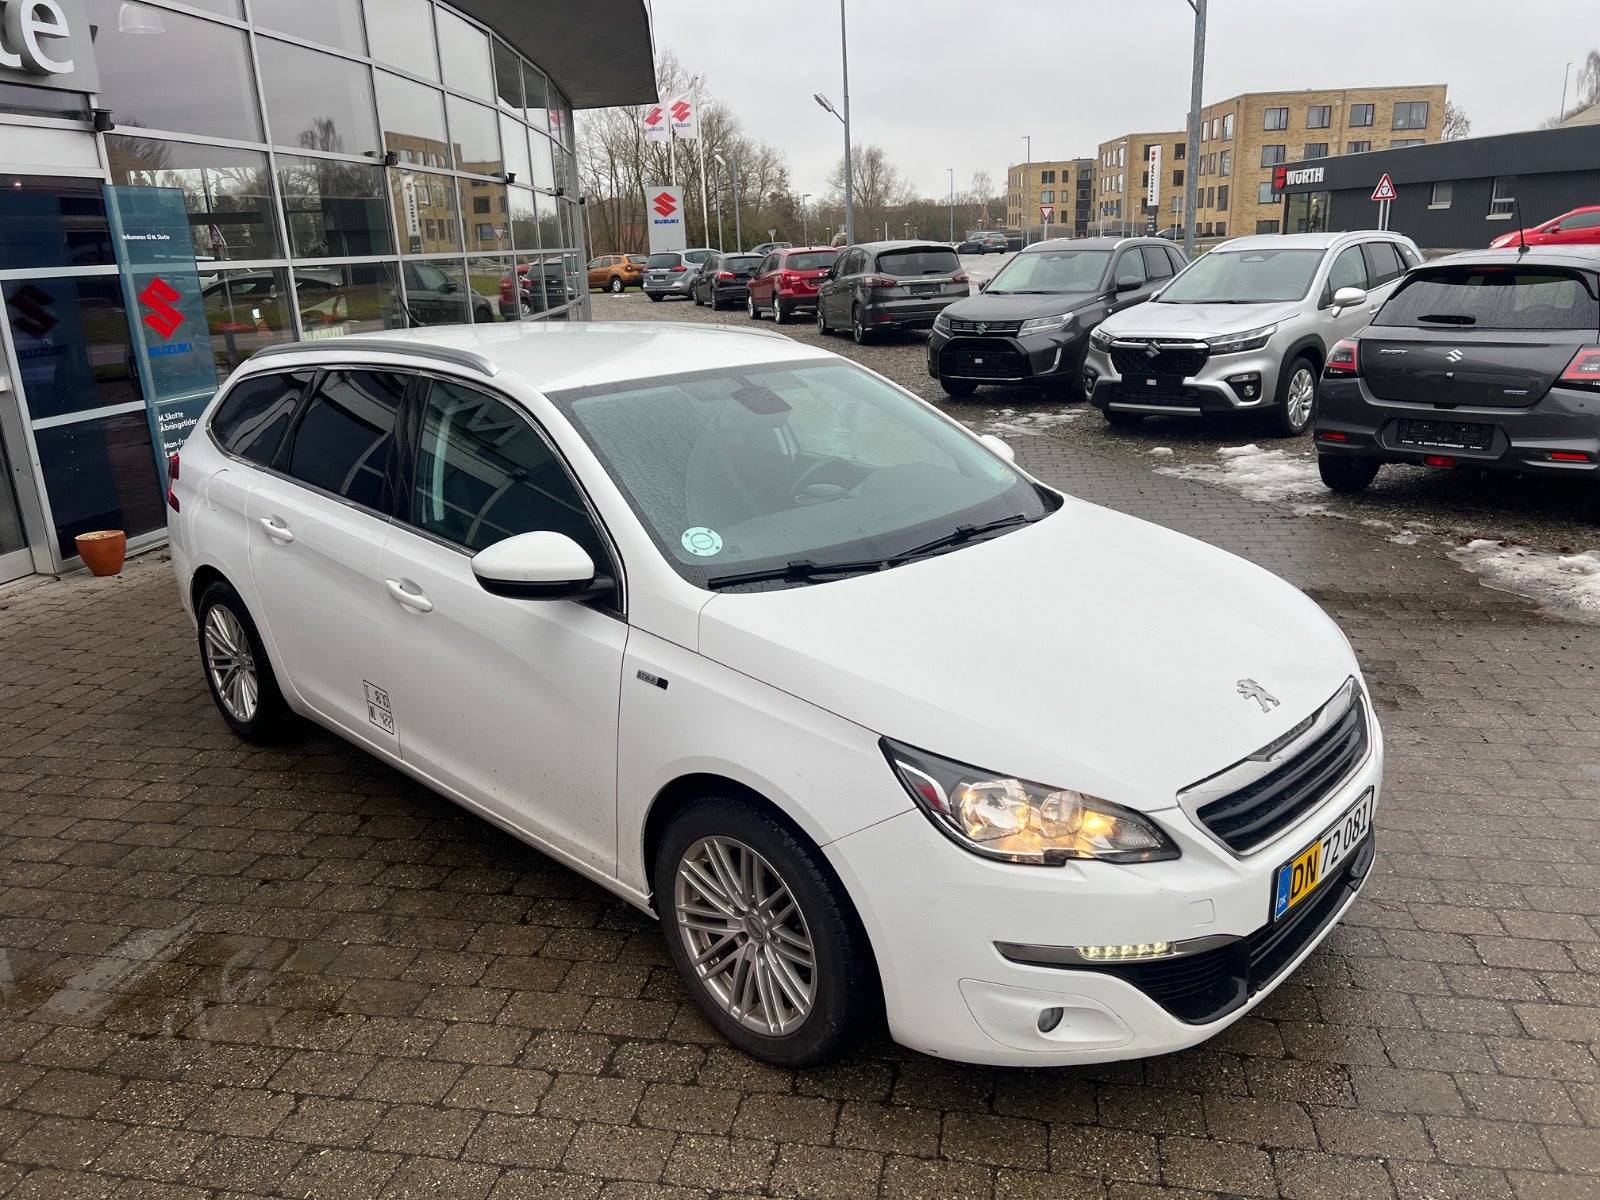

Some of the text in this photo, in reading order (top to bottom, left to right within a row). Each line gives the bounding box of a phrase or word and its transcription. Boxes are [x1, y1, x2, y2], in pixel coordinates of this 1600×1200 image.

[1286, 167, 1325, 185] WÜRTH
[148, 342, 192, 358] SUZUKI
[160, 419, 197, 432] Åbningstider
[1291, 849, 1318, 900] DN
[1321, 829, 1340, 874] 72
[1343, 802, 1367, 851] 081
